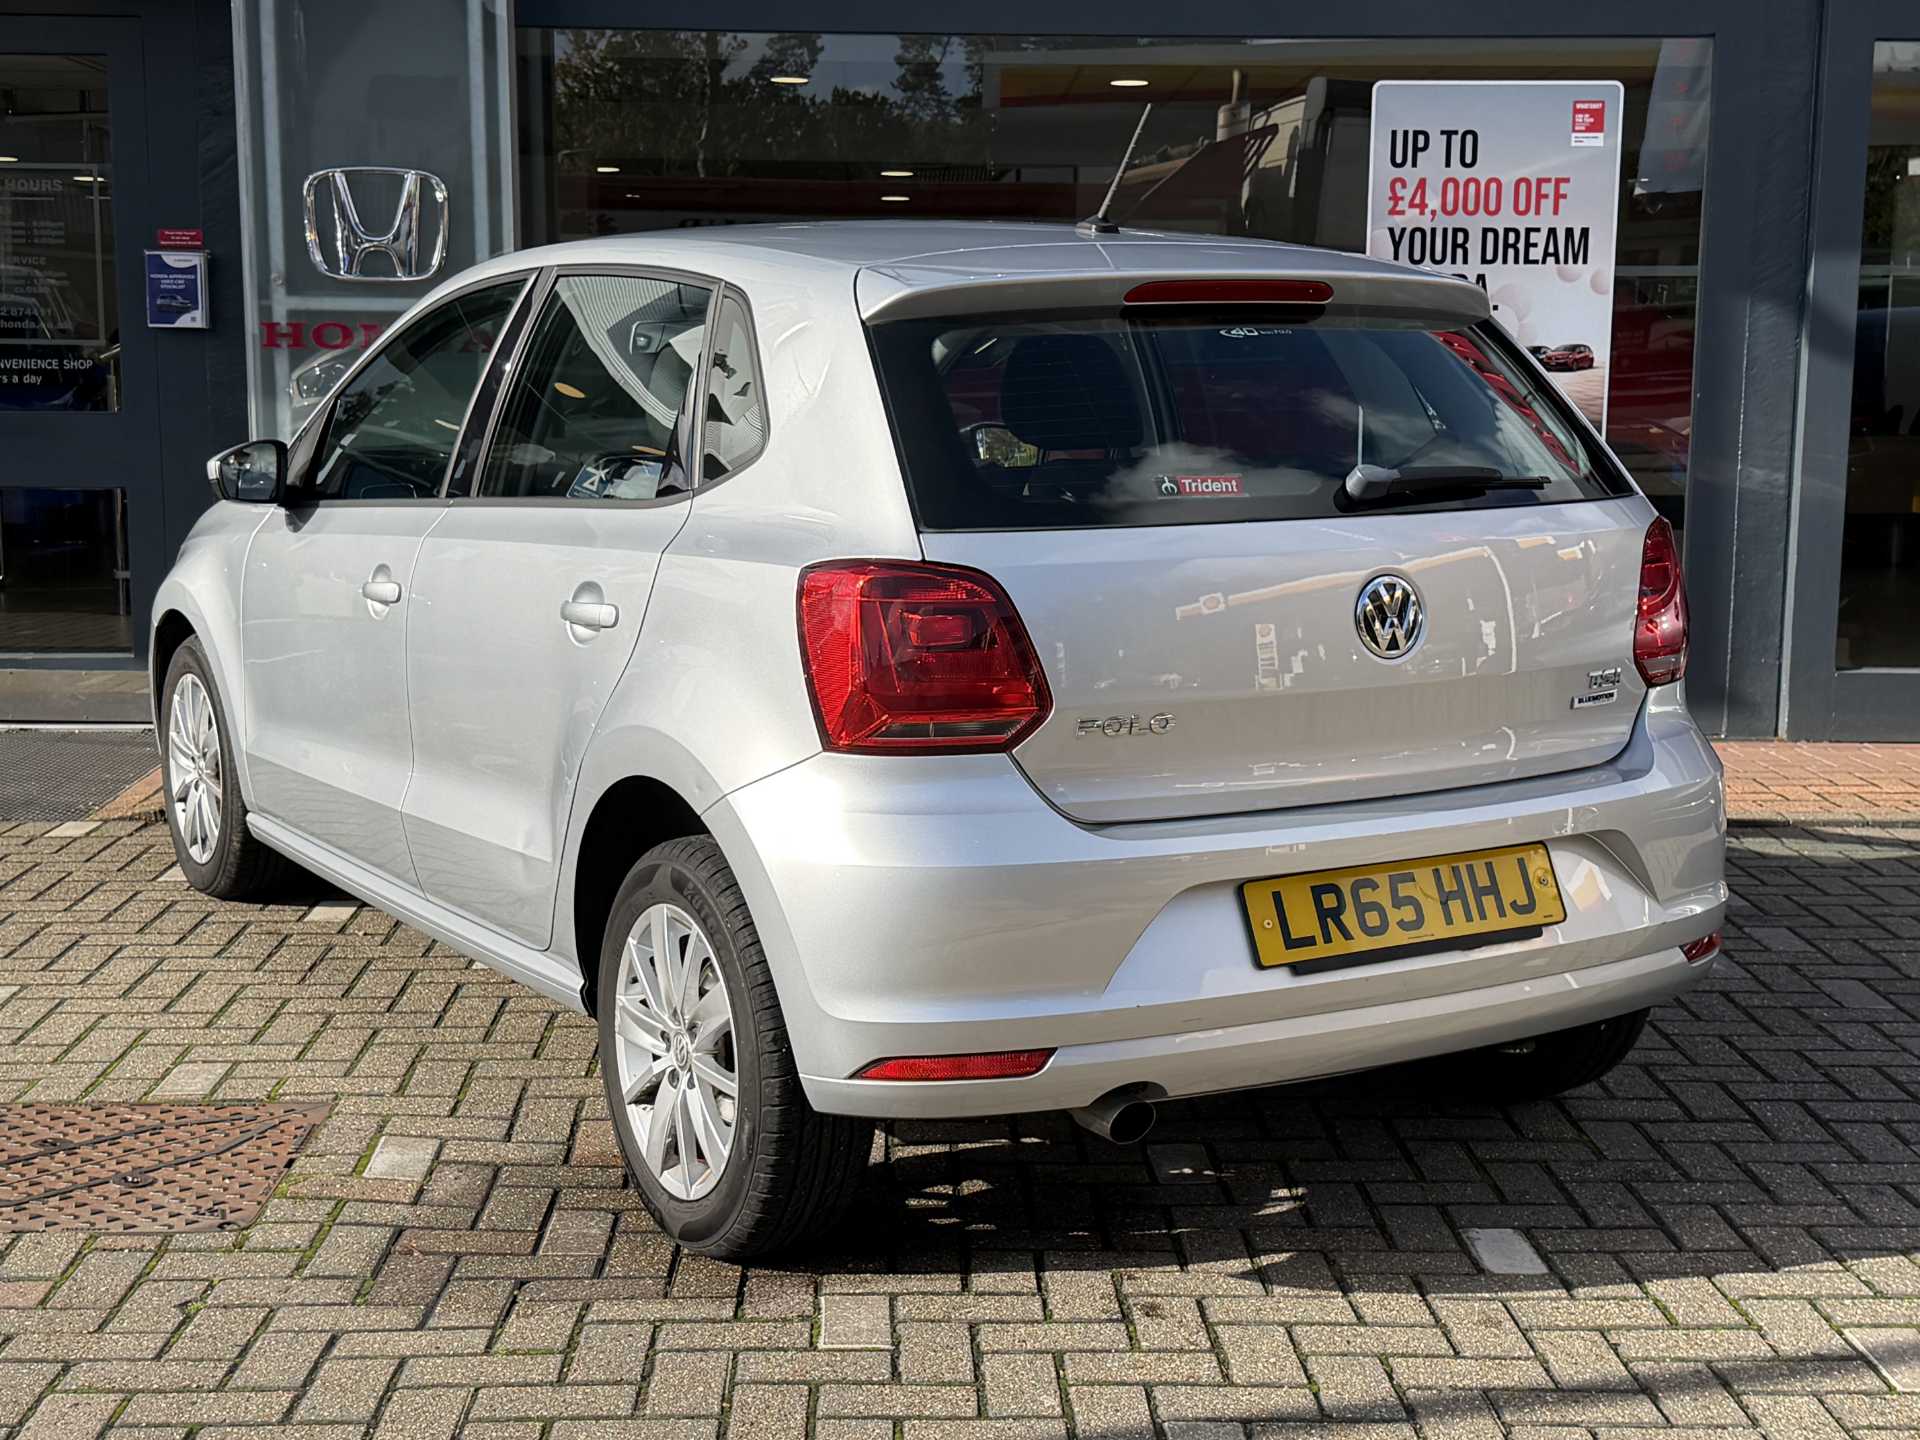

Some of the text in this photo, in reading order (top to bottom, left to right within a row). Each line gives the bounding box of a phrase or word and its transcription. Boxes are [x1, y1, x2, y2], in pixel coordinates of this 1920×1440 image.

[1390, 130, 1479, 169] UP TO
[5, 177, 64, 192] HOURS
[1387, 176, 1571, 222] £4,000 OFF
[1387, 227, 1590, 265] YOUR DREAM
[1, 256, 48, 265] ERVICE
[63, 359, 94, 370] SHOP
[12, 376, 19, 384] a
[23, 373, 42, 385] day
[1181, 479, 1238, 493] Trident
[1075, 712, 1177, 738] POLO
[1272, 856, 1538, 950] LR65 HHJ
